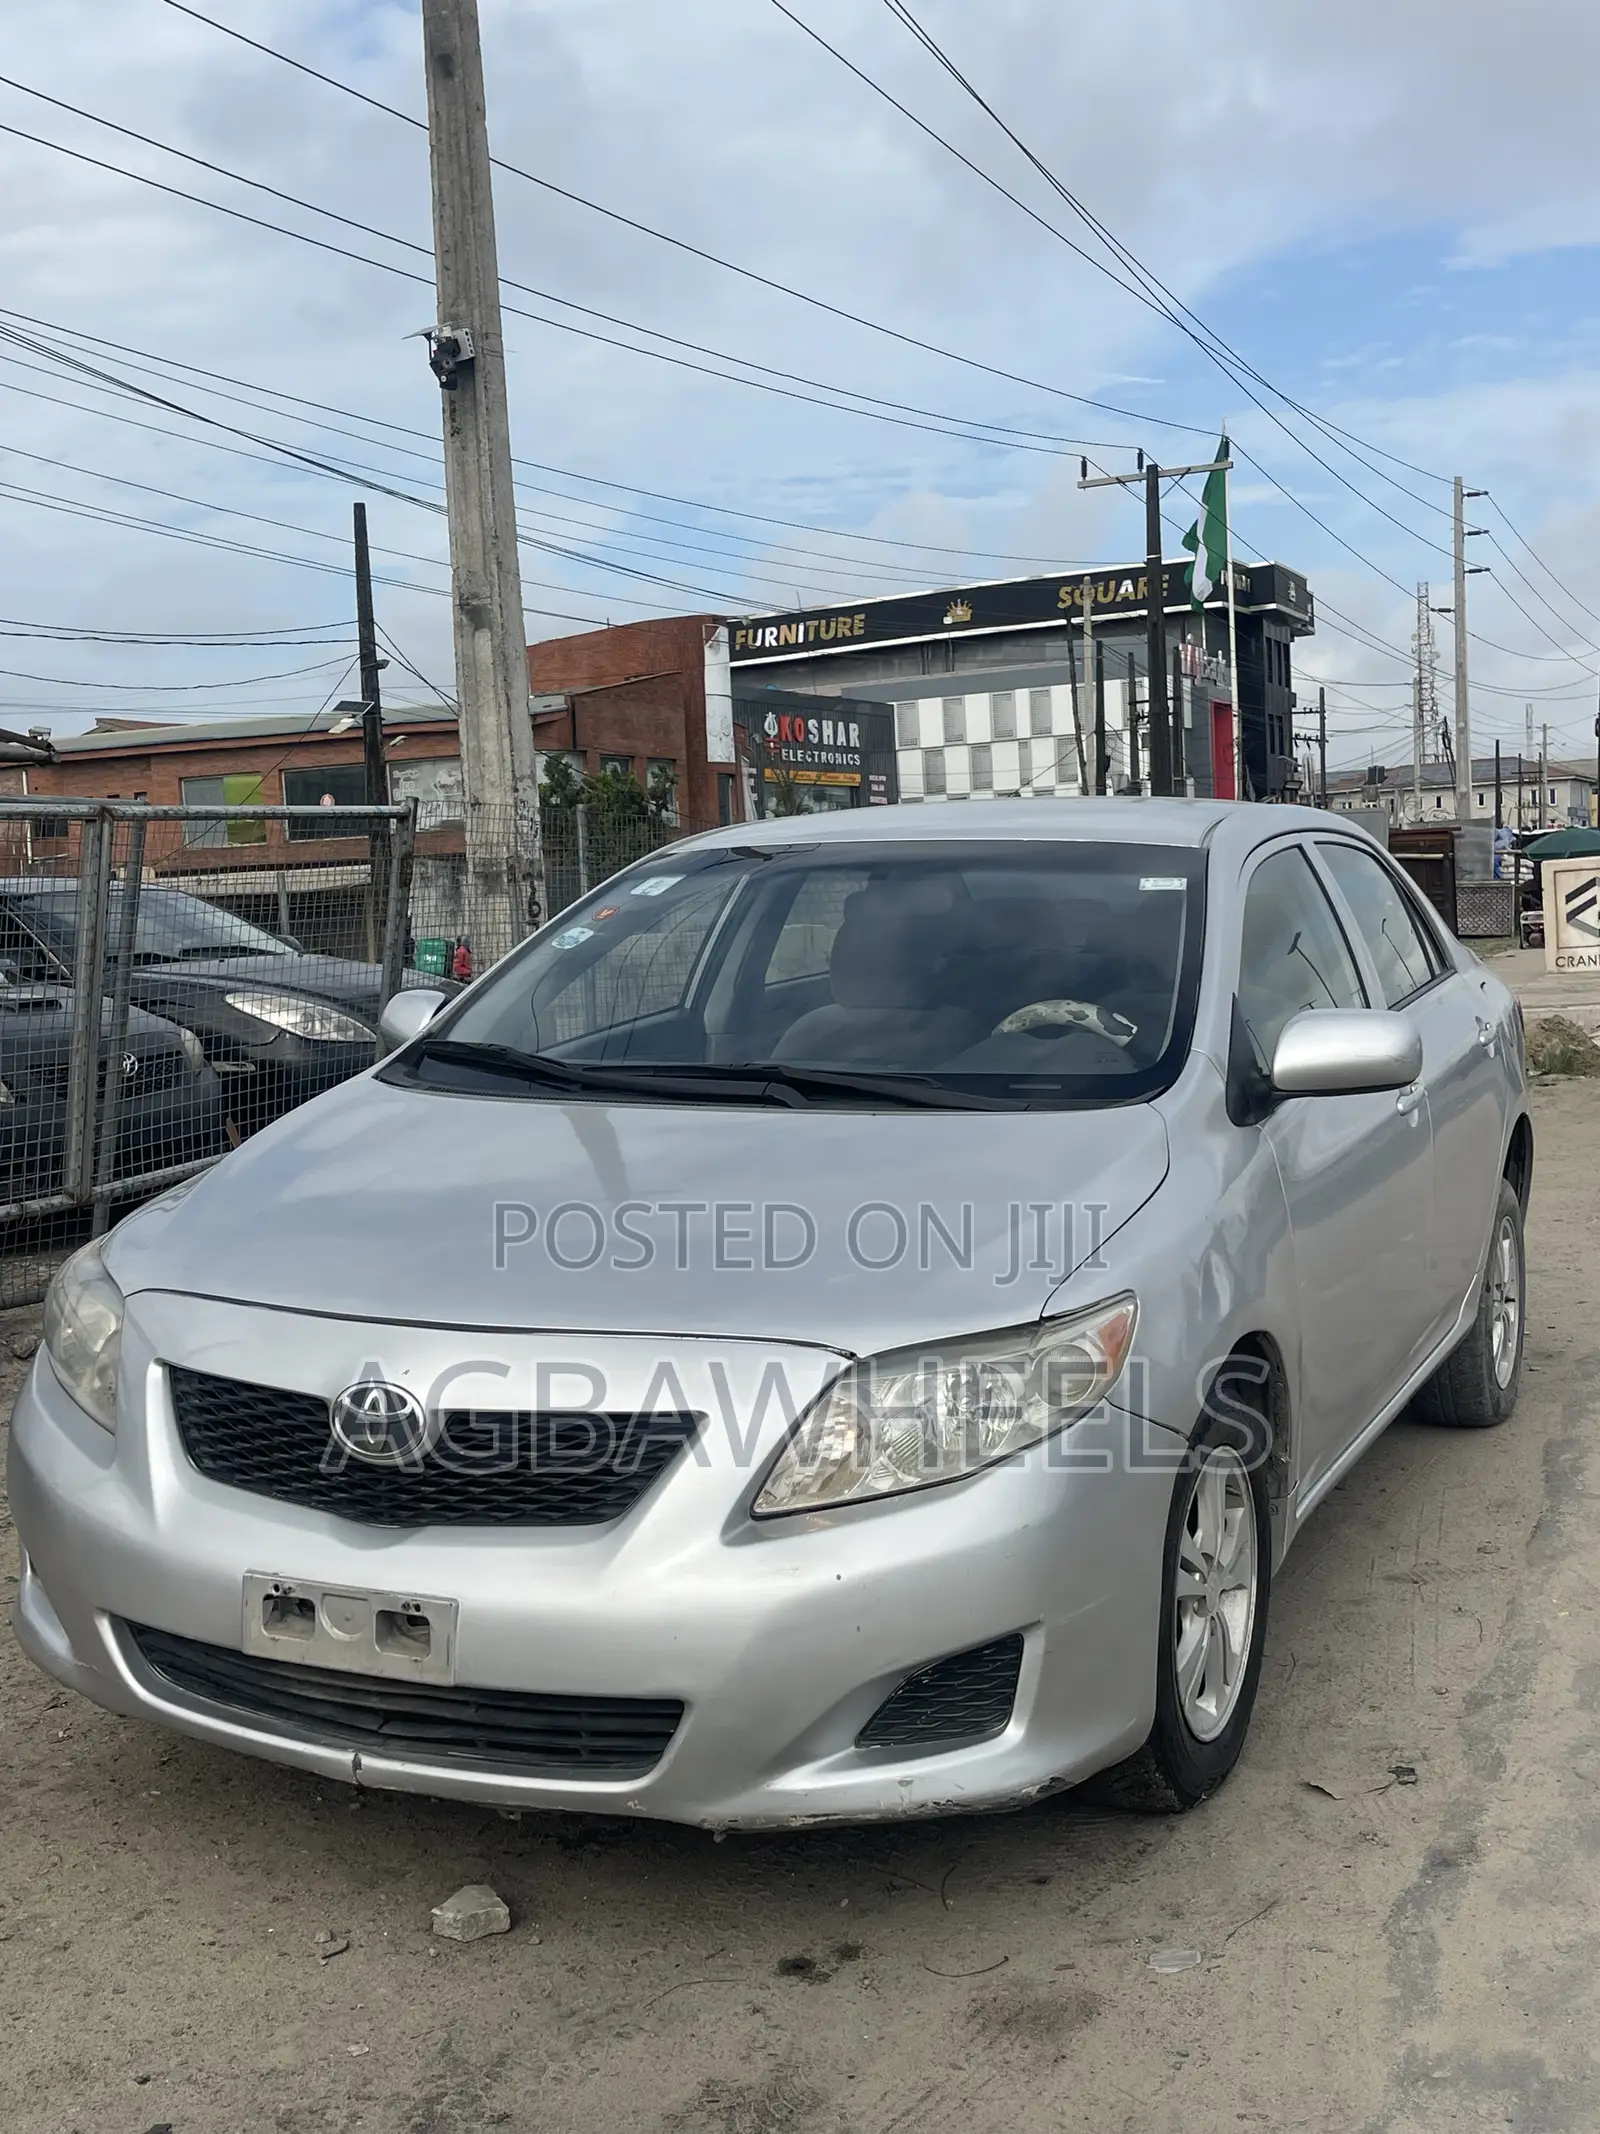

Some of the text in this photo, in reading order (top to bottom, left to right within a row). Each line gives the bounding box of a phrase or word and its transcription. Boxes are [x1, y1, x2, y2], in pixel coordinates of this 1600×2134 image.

[735, 614, 865, 650] FURNITURE
[779, 715, 861, 748] KOSHAR
[781, 748, 861, 766] ELECTRONICS
[1555, 954, 1600, 968] CRAN
